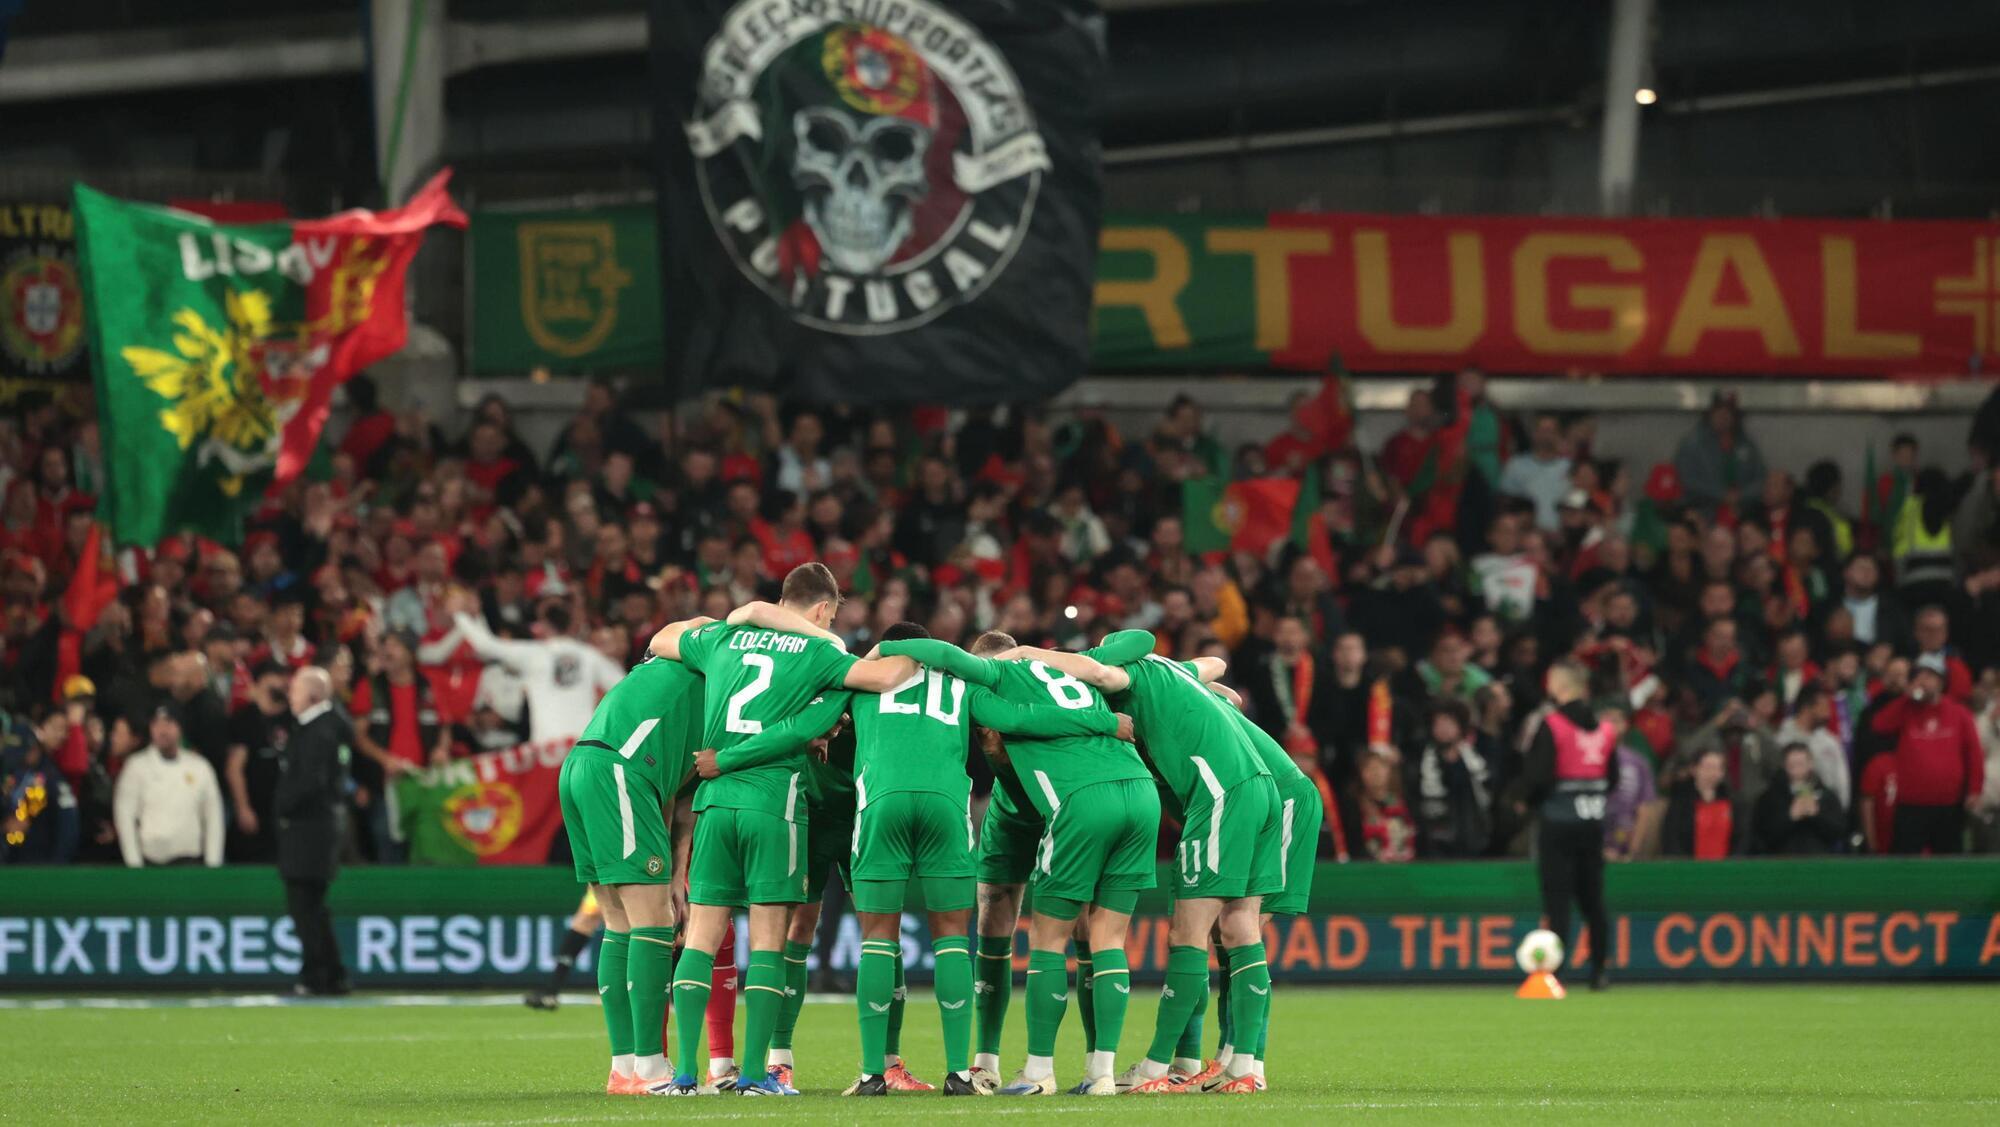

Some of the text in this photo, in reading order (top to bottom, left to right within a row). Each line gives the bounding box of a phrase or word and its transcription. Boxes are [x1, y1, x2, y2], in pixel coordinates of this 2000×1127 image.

[729, 631, 808, 653] COLEMAN
[725, 653, 774, 734] 2
[879, 668, 966, 725] 20
[1029, 660, 1094, 709] 8
[1180, 840, 1201, 874] 11
[0, 916, 303, 974] FIXTURES
[1391, 916, 1515, 970] THE
[1653, 912, 1959, 968] CONNECT
